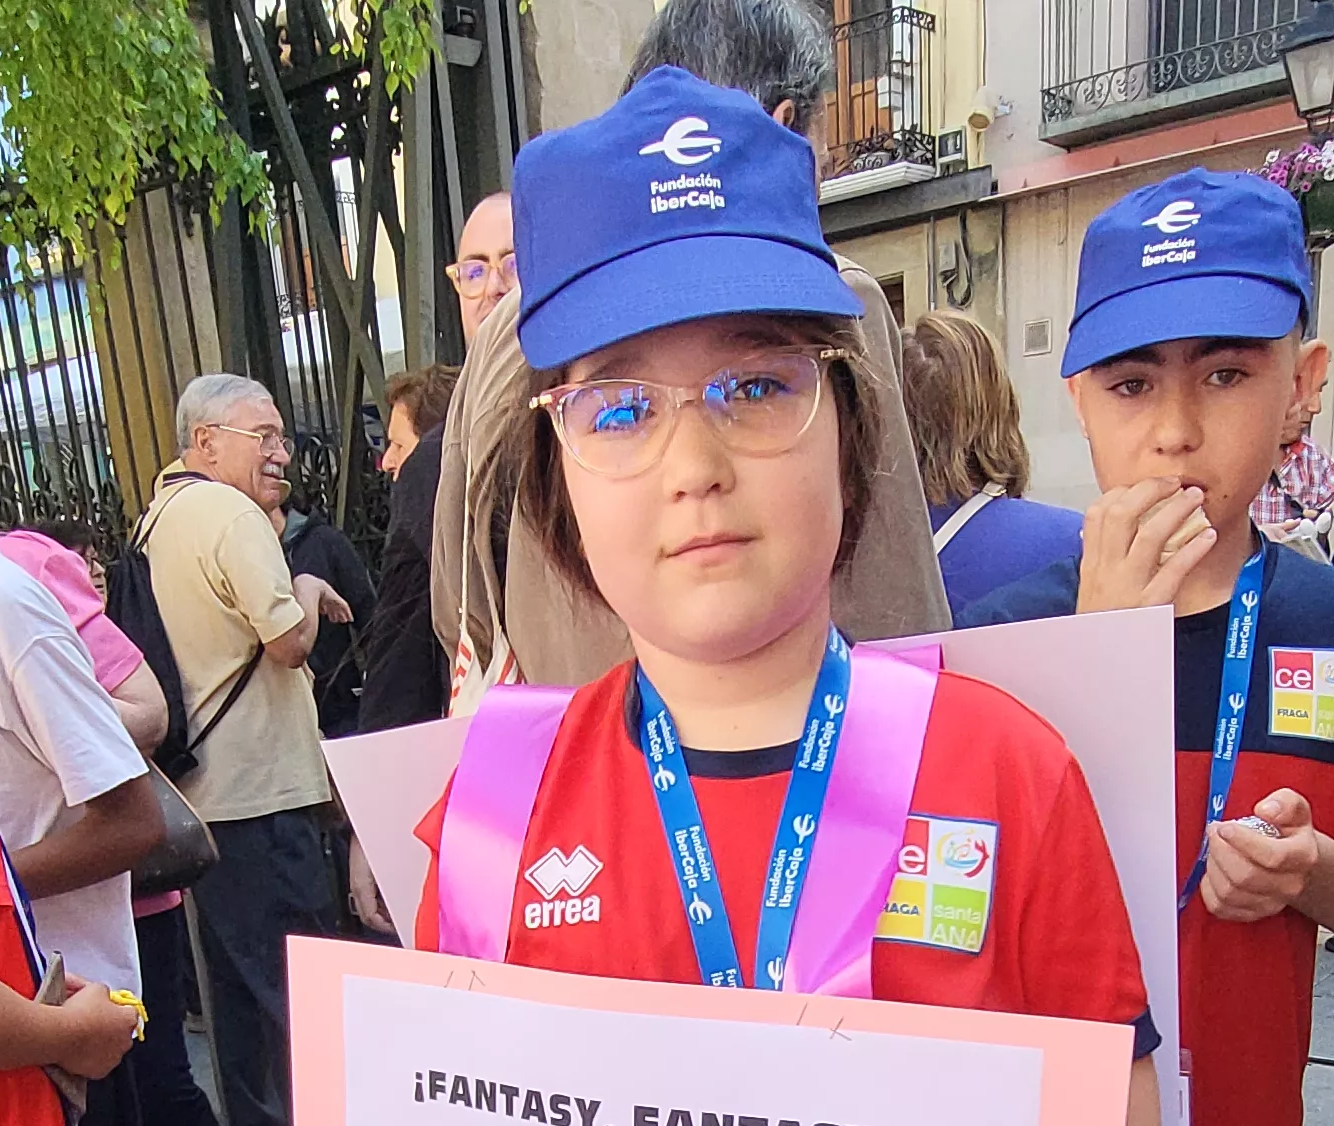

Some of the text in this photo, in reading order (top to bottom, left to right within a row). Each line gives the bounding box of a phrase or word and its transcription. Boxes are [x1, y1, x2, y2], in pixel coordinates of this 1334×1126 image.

[650, 173, 721, 194] Fundación
[650, 190, 725, 213] iberCaja
[1275, 668, 1312, 689] ce
[1277, 708, 1309, 719] FRAGA
[675, 829, 699, 889] iberCaja
[689, 825, 711, 882] Fundación
[765, 849, 787, 908] Fundación
[524, 895, 601, 929] errea
[933, 904, 982, 924] santa
[933, 923, 979, 948] ANA
